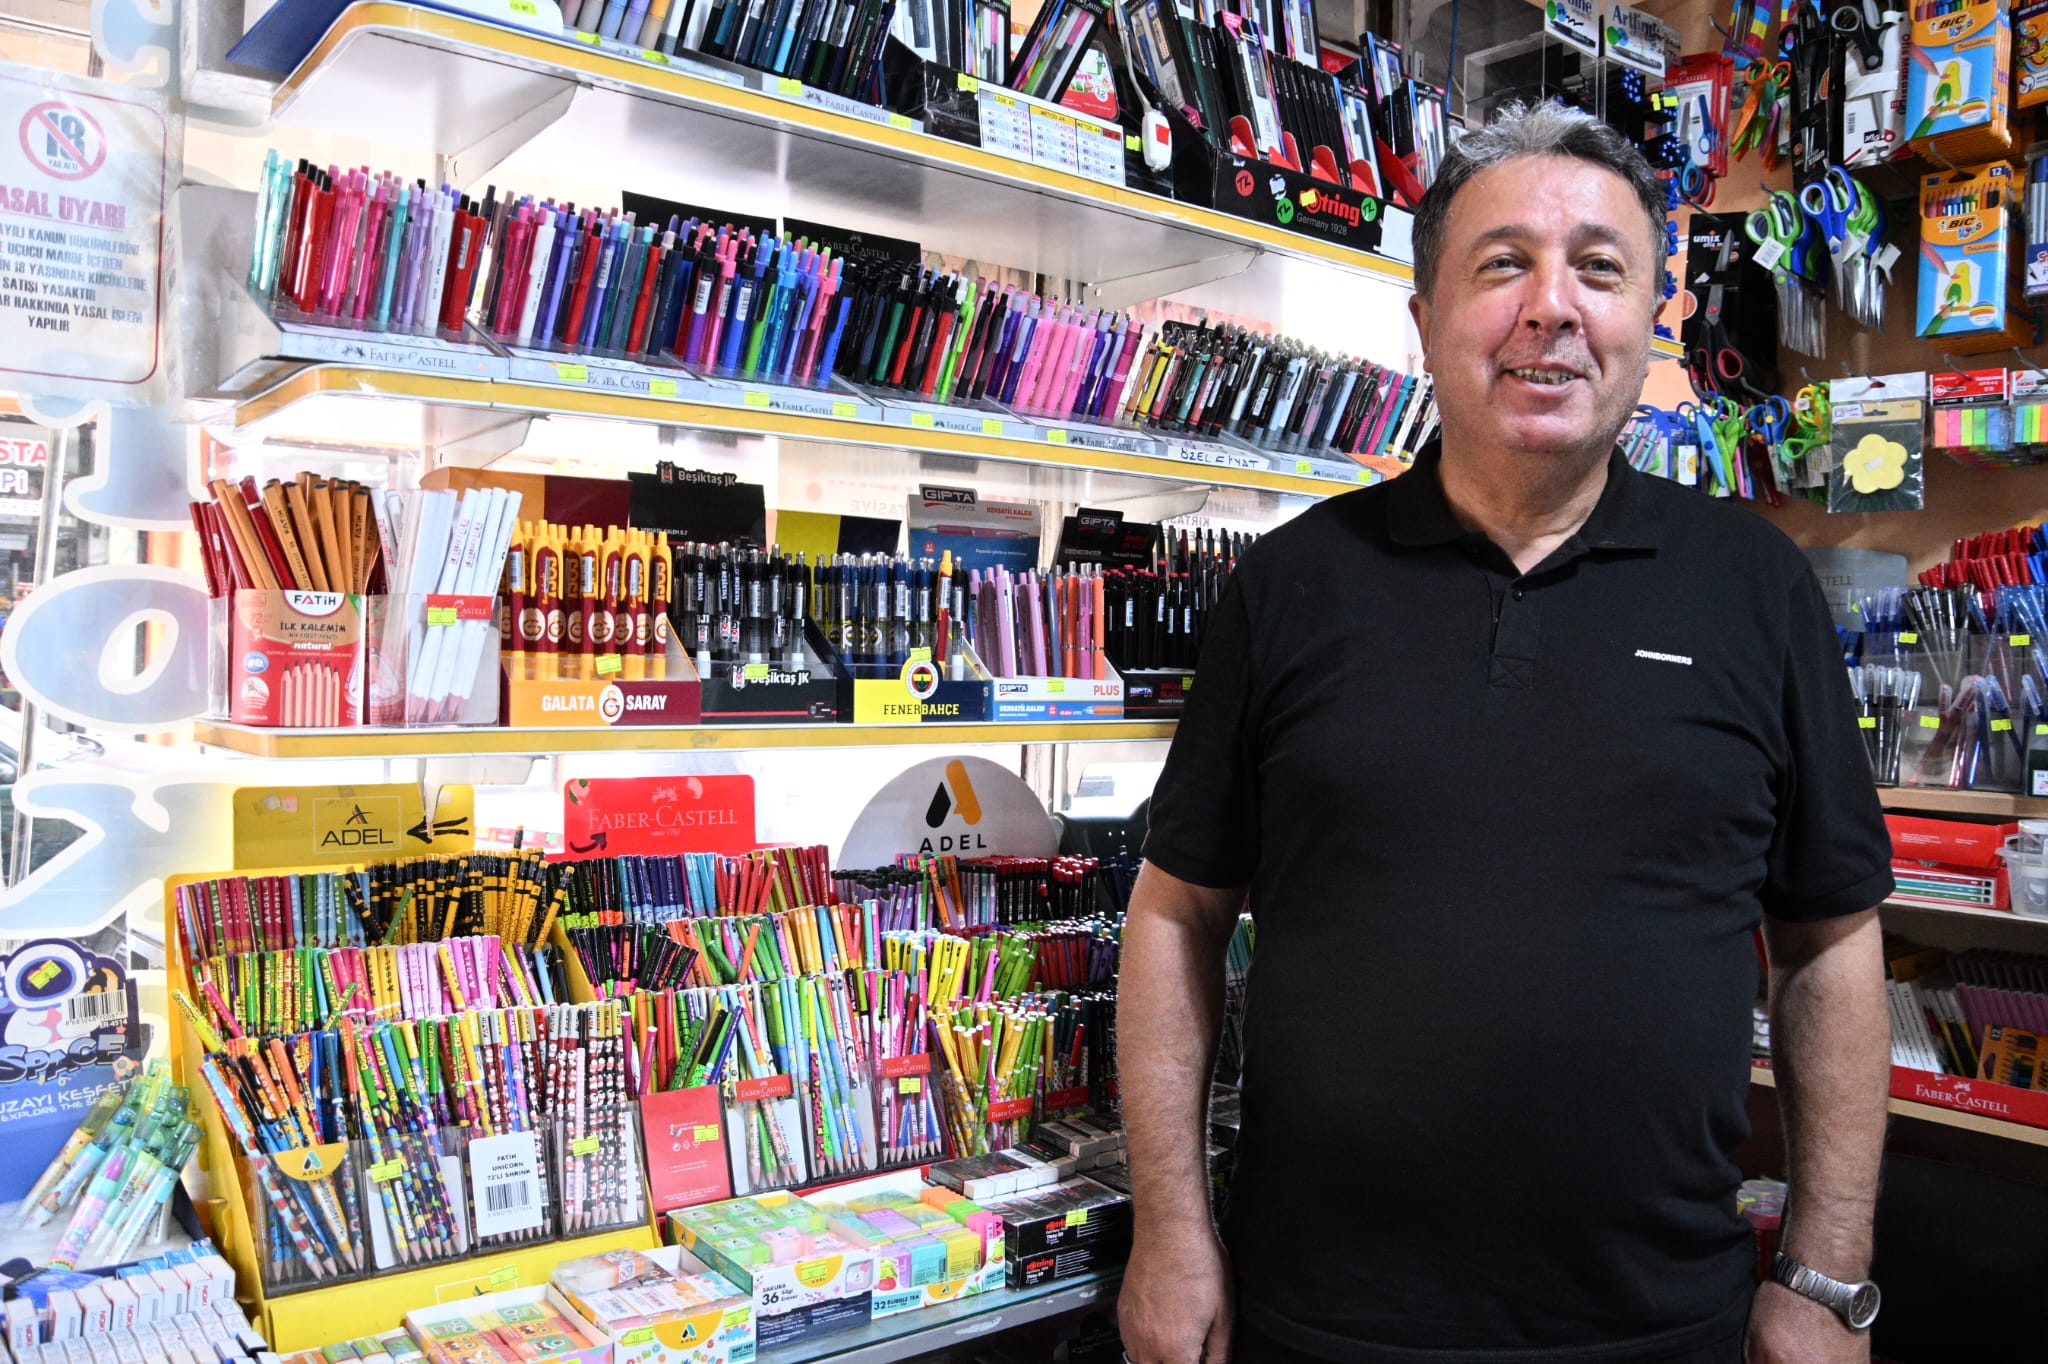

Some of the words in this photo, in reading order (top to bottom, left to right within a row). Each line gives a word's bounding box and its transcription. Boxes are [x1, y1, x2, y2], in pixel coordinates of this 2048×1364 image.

[1939, 14, 1966, 30] BIC
[825, 95, 887, 122] FABER-CASTELL
[46, 112, 86, 160] 18
[1991, 167, 2002, 176] 12
[58, 194, 127, 230] UYARI
[1300, 187, 1361, 228] otring
[1296, 212, 1329, 231] Germany
[1331, 222, 1348, 236] 1928
[1948, 216, 1975, 230] BIC
[28, 228, 67, 246] KANUN
[14, 260, 26, 274] 18
[42, 282, 97, 302] YASAKTIR
[14, 295, 70, 316] HAKKINDA
[73, 303, 109, 320] YASAL
[28, 315, 70, 332] YAPILIR
[678, 470, 723, 487] Beşiktaş
[724, 472, 737, 487] JK
[924, 488, 974, 503] GIPTA
[1080, 515, 1117, 528] GIPTA
[280, 621, 297, 631] İLK
[300, 622, 346, 633] KALEMİM
[293, 641, 332, 651] natural
[797, 671, 810, 686] JK
[999, 683, 1028, 693] GIPTA
[1093, 684, 1120, 697] PLUS
[541, 694, 596, 713] GALATA
[625, 694, 668, 712] SARAY
[883, 703, 960, 718] FENERBAHÇE
[588, 806, 739, 832] FABER-CASTELL
[320, 827, 395, 848] ADEL
[918, 833, 988, 855] ADEL
[0, 1033, 128, 1084] SPACE
[741, 1084, 788, 1098] FABER-CASTELL
[1915, 1084, 2010, 1114] FABER-CASTELL
[492, 1162, 524, 1172] UNICORN
[505, 1169, 531, 1178] SHRINK
[762, 1283, 787, 1293] SAKURA
[761, 1291, 780, 1306] 36
[873, 1300, 887, 1311] 32
[887, 1296, 908, 1305] BUBBLE
[908, 1294, 920, 1302] TEA
